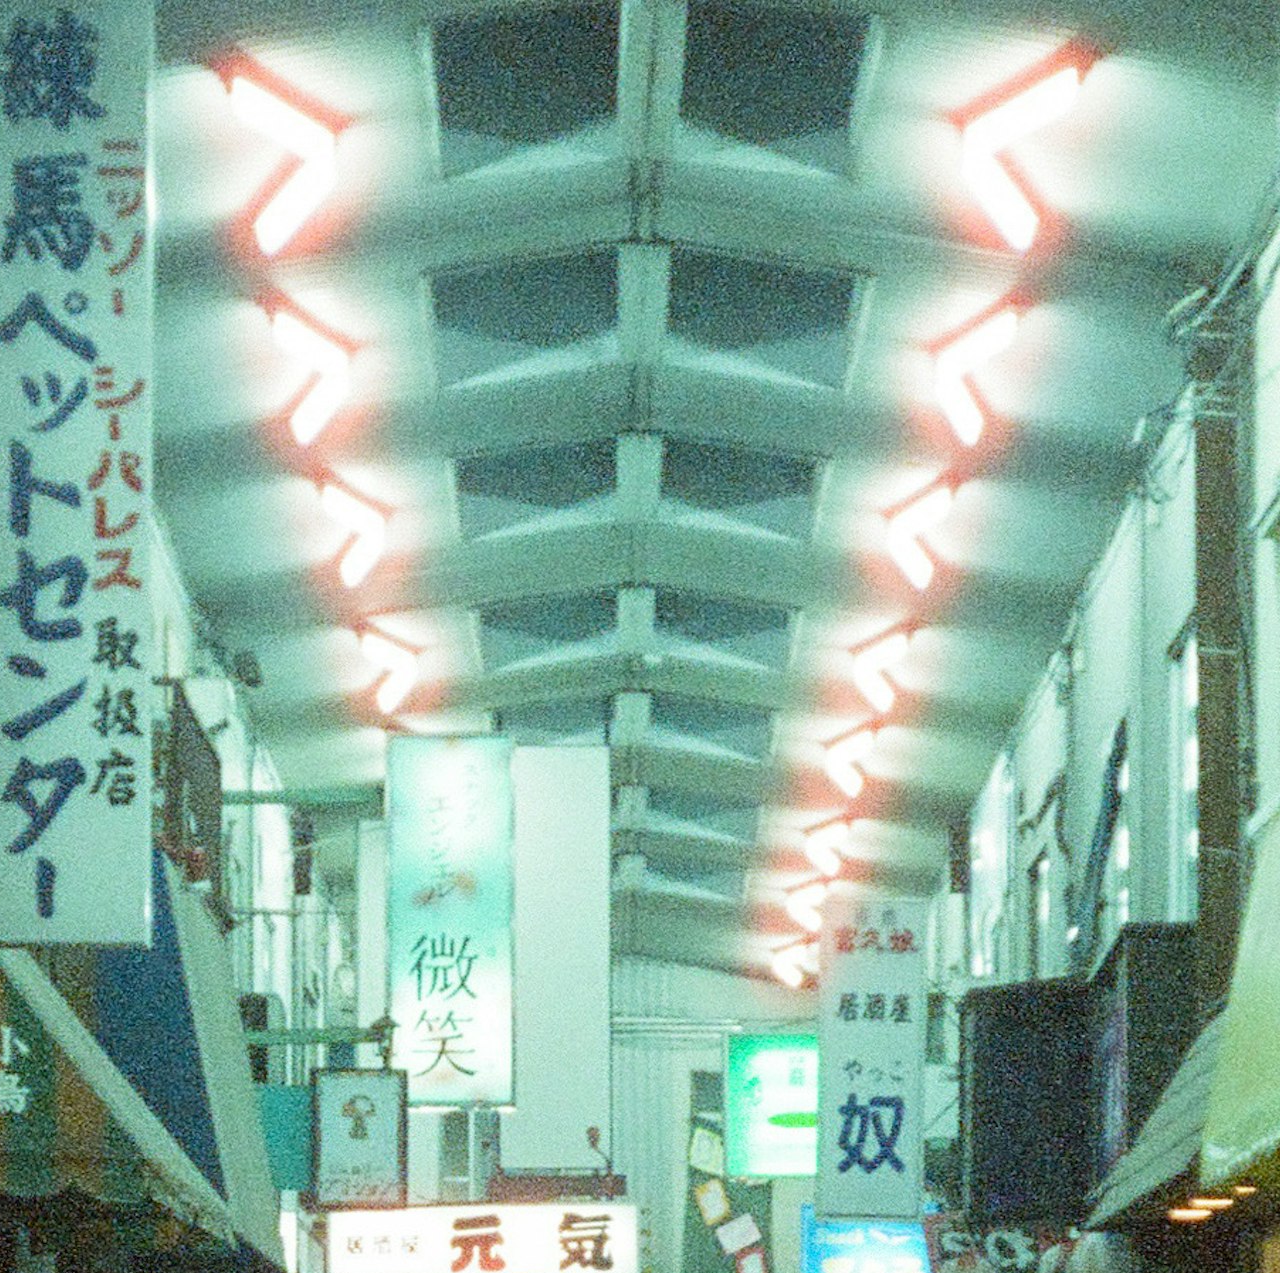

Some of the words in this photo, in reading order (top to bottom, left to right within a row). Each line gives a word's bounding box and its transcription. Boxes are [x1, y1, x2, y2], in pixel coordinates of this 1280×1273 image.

[409, 930, 480, 1079] 微笑
[837, 1093, 905, 1174] 奴
[449, 1213, 615, 1273] 元気
